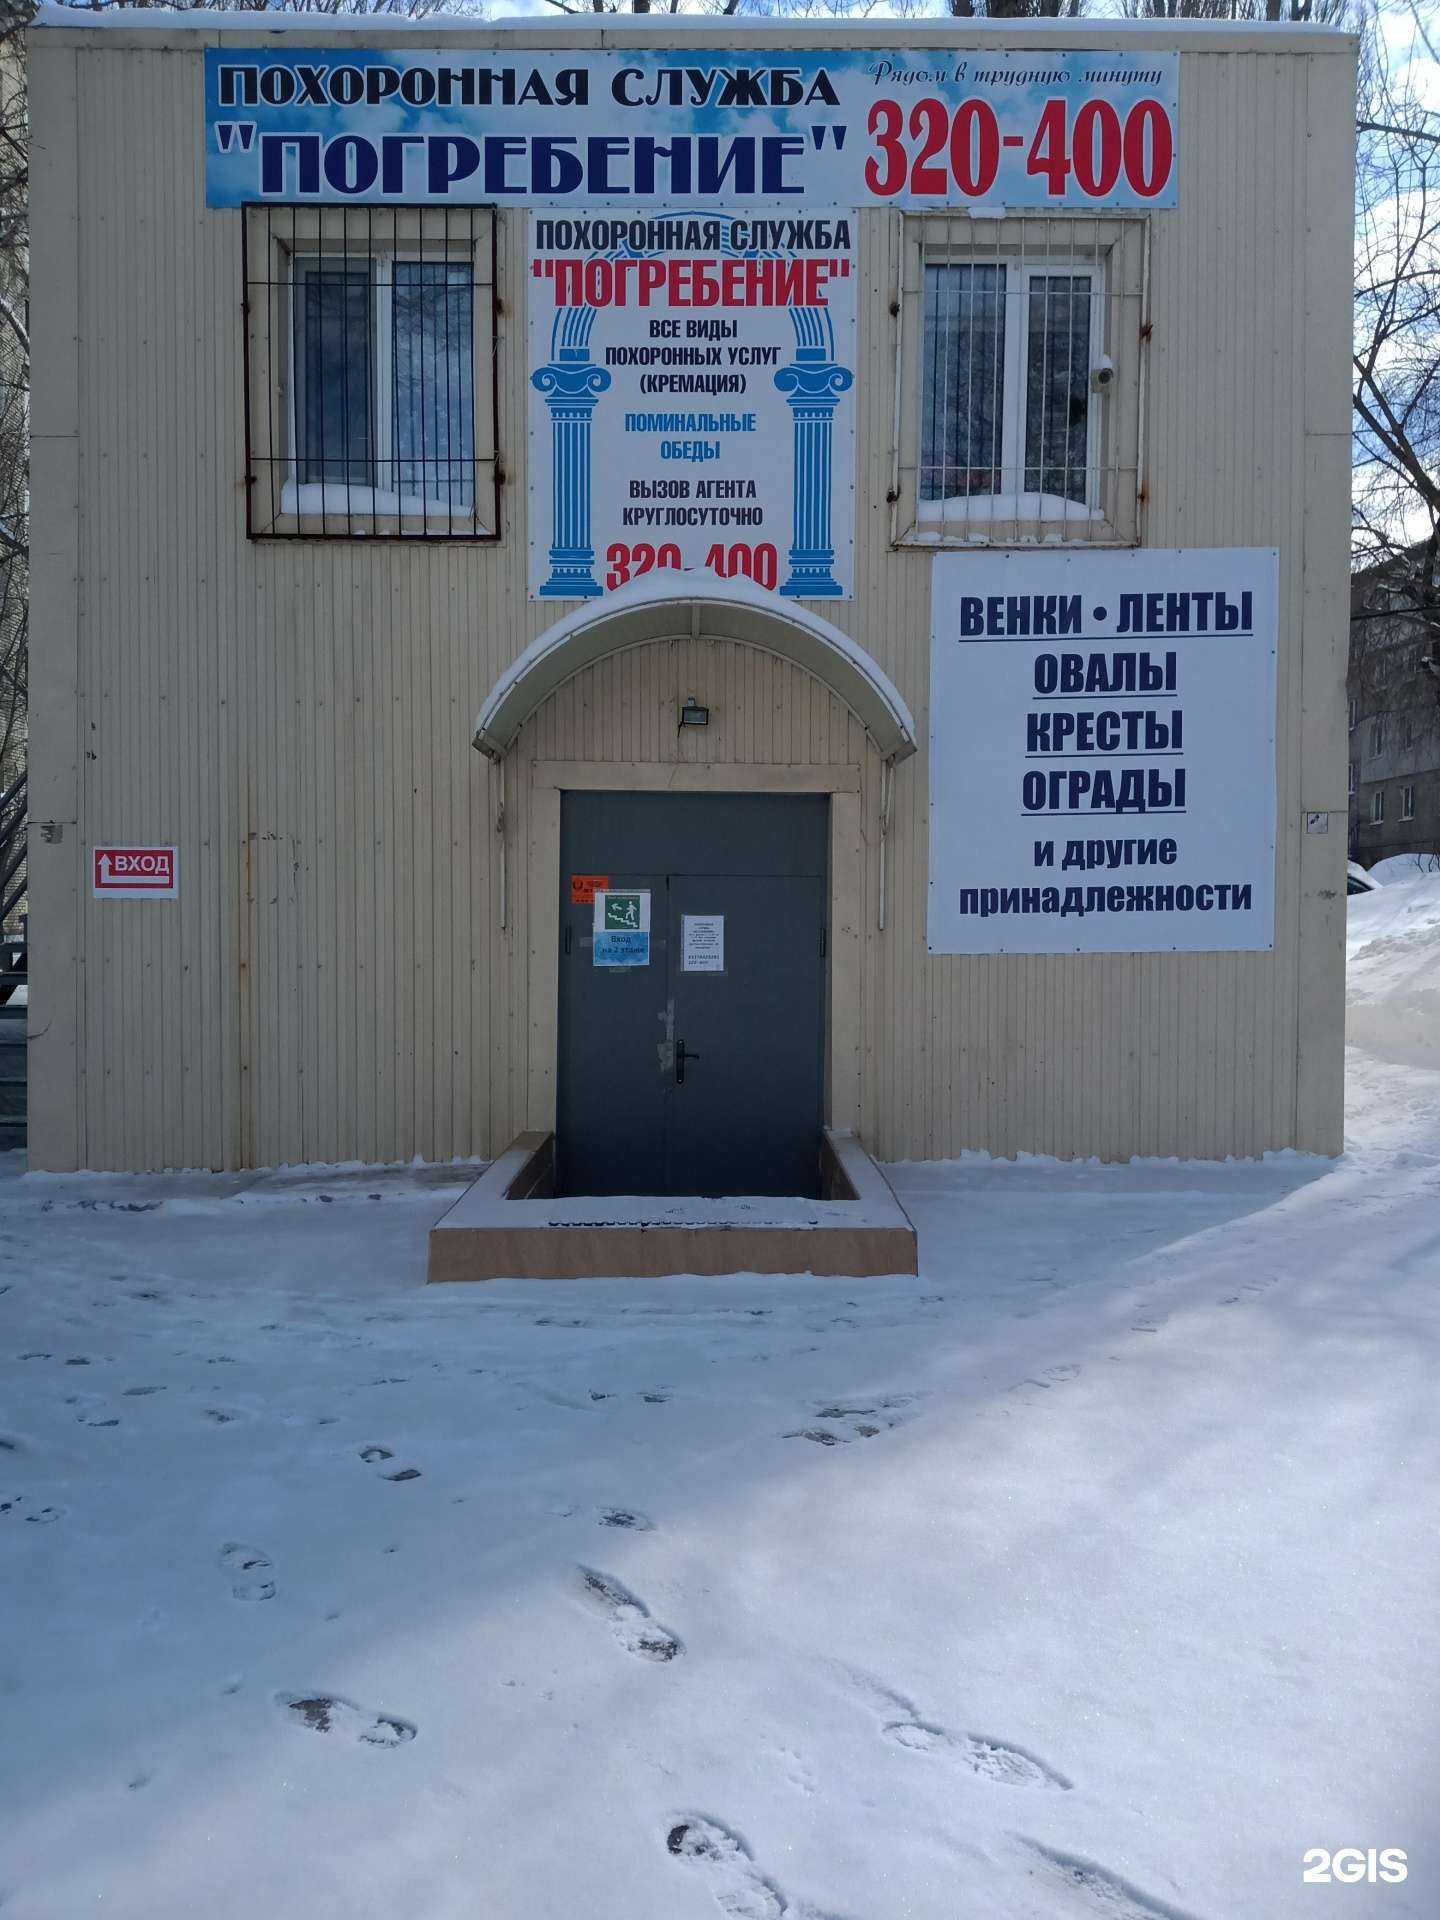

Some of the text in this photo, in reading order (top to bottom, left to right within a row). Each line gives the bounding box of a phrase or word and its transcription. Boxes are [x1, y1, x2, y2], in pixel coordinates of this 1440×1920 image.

[218, 65, 841, 107] ПОХОРОННАЯ СЛУЖБА
[869, 60, 1163, 87] Рядом в трудную минуту
[215, 121, 848, 195] "ПОГРЕБЕНИЕ"
[864, 98, 1173, 197] 320-400
[536, 219, 851, 251] ПОХОРОННАЯ СЛУЖБА
[533, 258, 849, 307] "ПОГРЕБЕНИЕ"
[649, 319, 738, 341] ВСЕ ВИДЫ
[605, 346, 782, 366] ПОХОРОННЫХ УСЛУГ
[640, 373, 747, 396] (КРЕМАЦИЯ)
[625, 413, 757, 432] ПОМИНАЛЬНЫЕ
[660, 440, 720, 462] ОБЕДЫ
[629, 480, 757, 499] ВЫЗОВ АГЕНТА
[622, 507, 763, 526] КРУГЛОСУТОЧНО
[959, 590, 1254, 637] ВЕНКИ ЛЕНТЫ
[1033, 651, 1178, 694] ОВАЛЫ
[1026, 710, 1184, 752] КРЕСТЫ
[1022, 768, 1187, 813] ОГРАДЫ
[114, 855, 170, 875] ВХОД
[1033, 837, 1178, 871] и другие
[959, 883, 1253, 918] принадлежности
[611, 935, 632, 945] Вход
